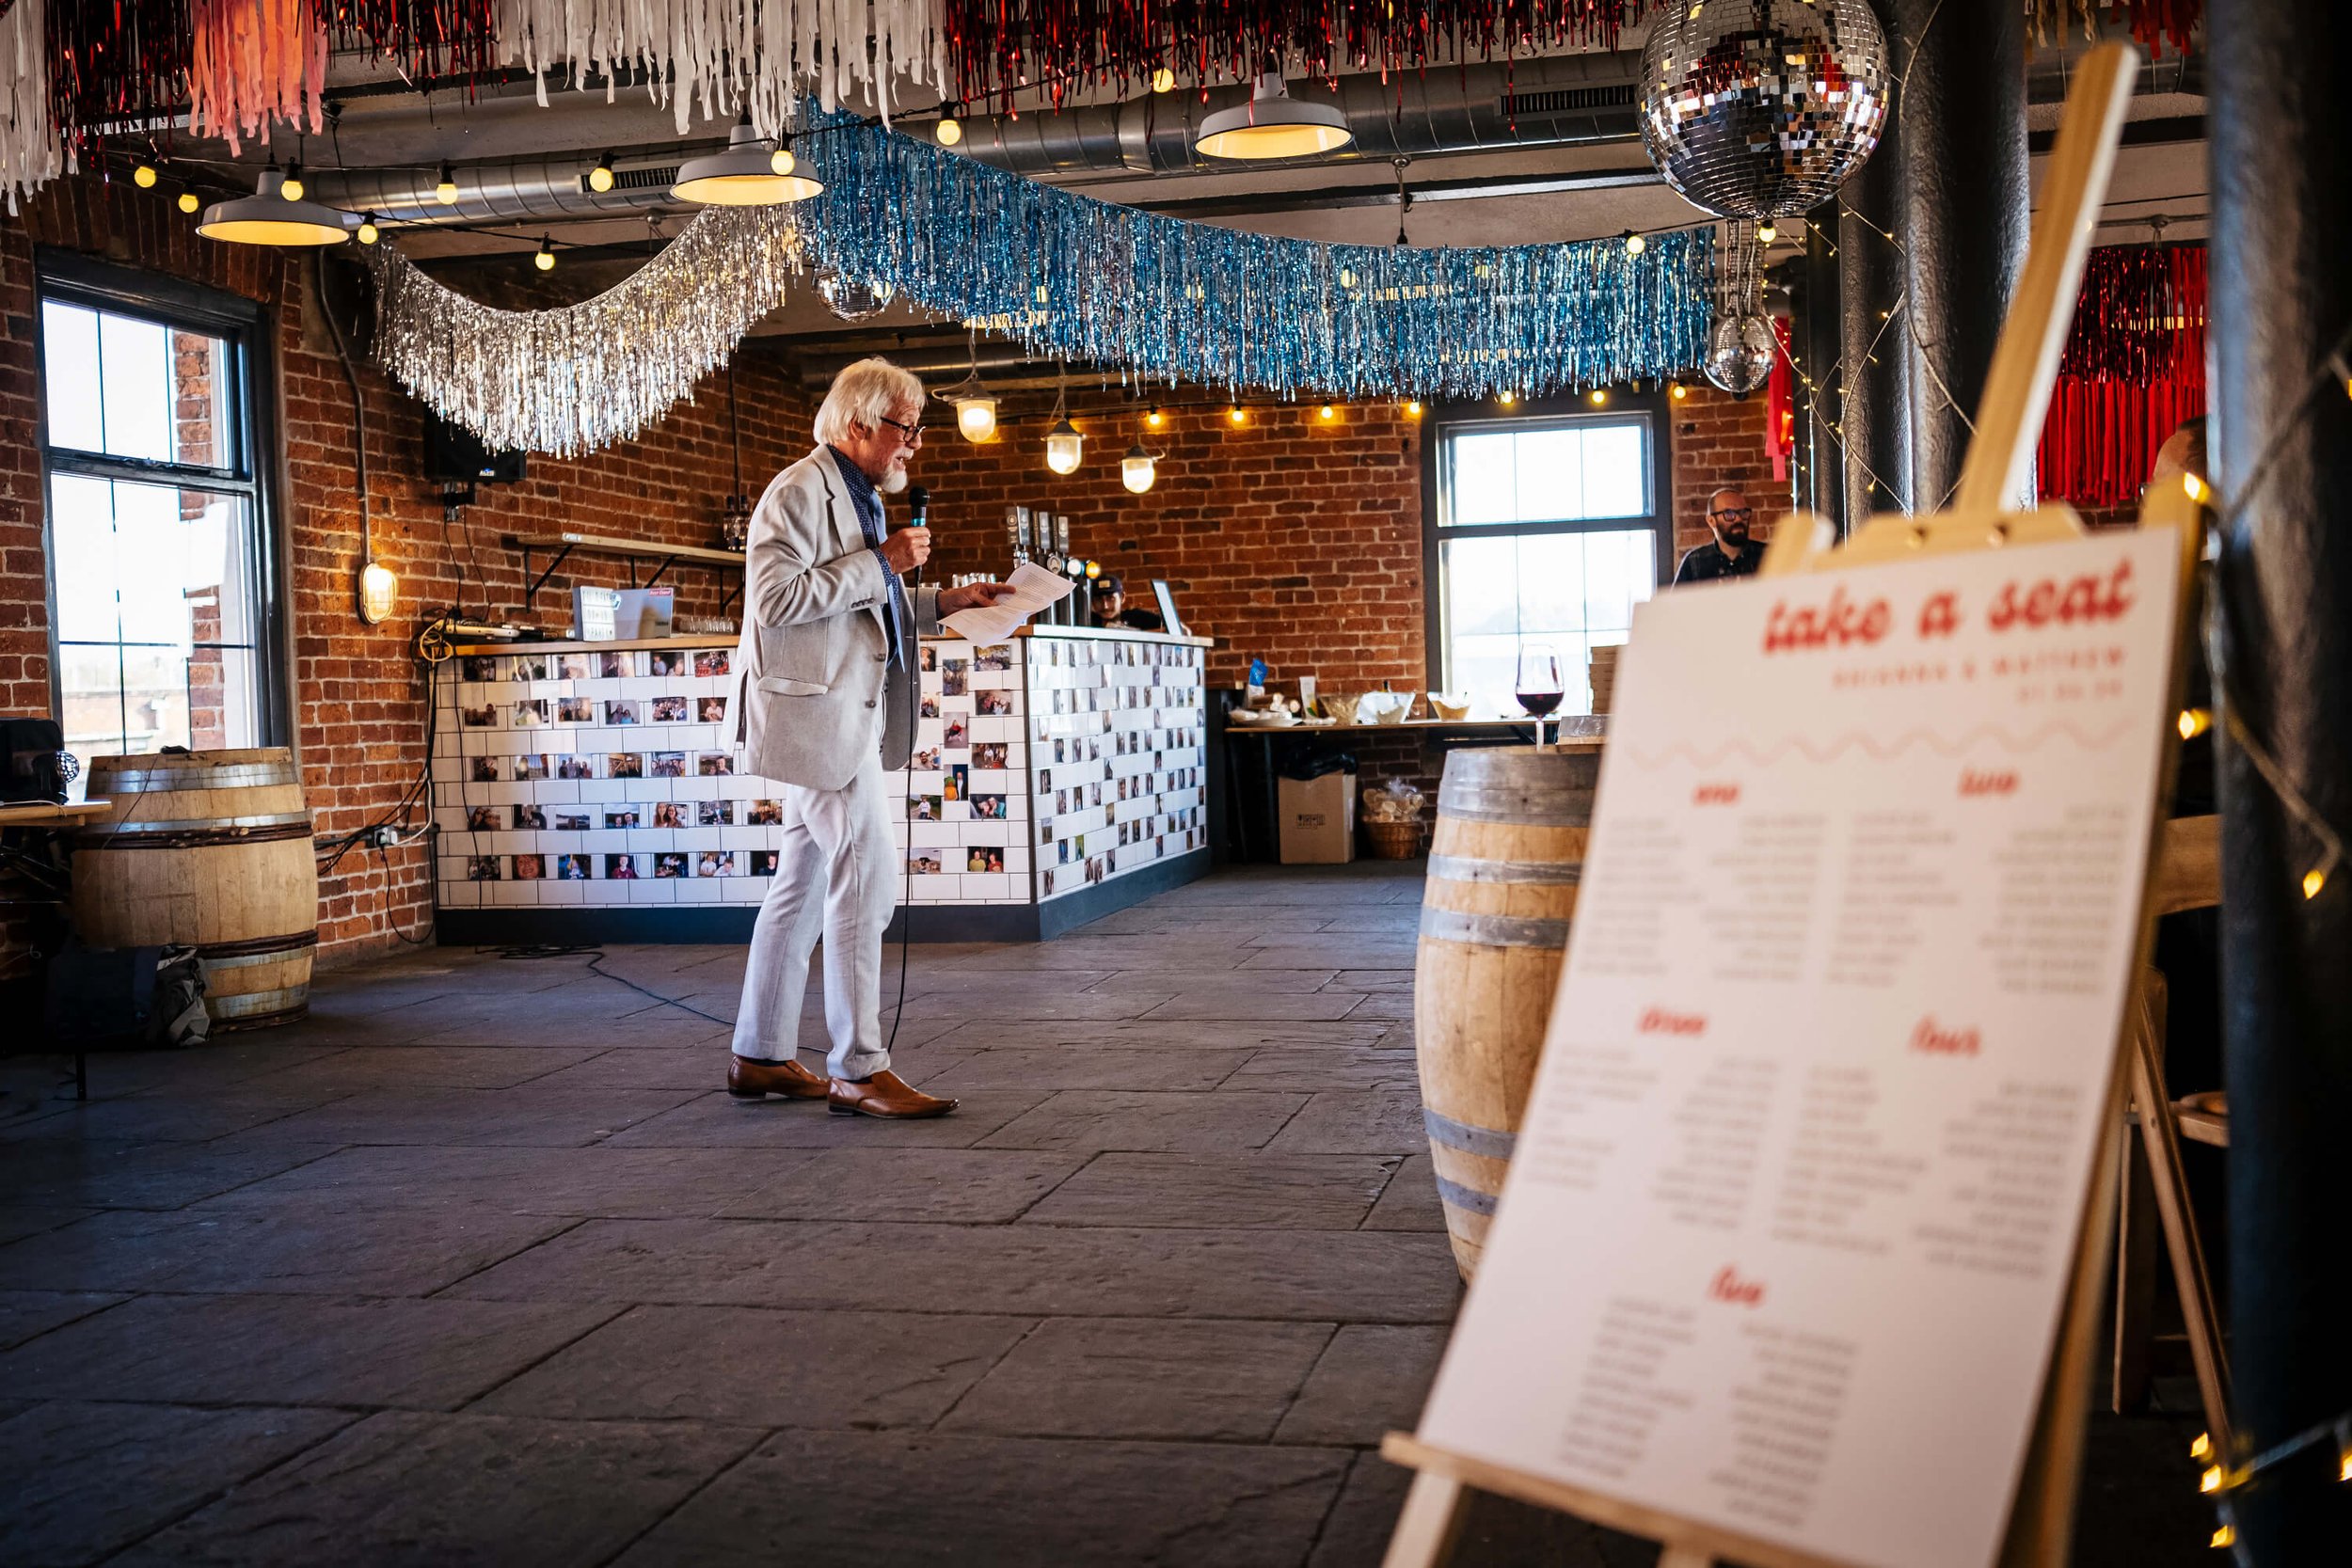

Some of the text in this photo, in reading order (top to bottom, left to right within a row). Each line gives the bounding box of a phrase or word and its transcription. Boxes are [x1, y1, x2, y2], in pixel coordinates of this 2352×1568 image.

[1762, 558, 2134, 655] take a seat
[1693, 783, 1741, 806] one
[1959, 768, 2021, 798] two
[1911, 1016, 1981, 1056] four
